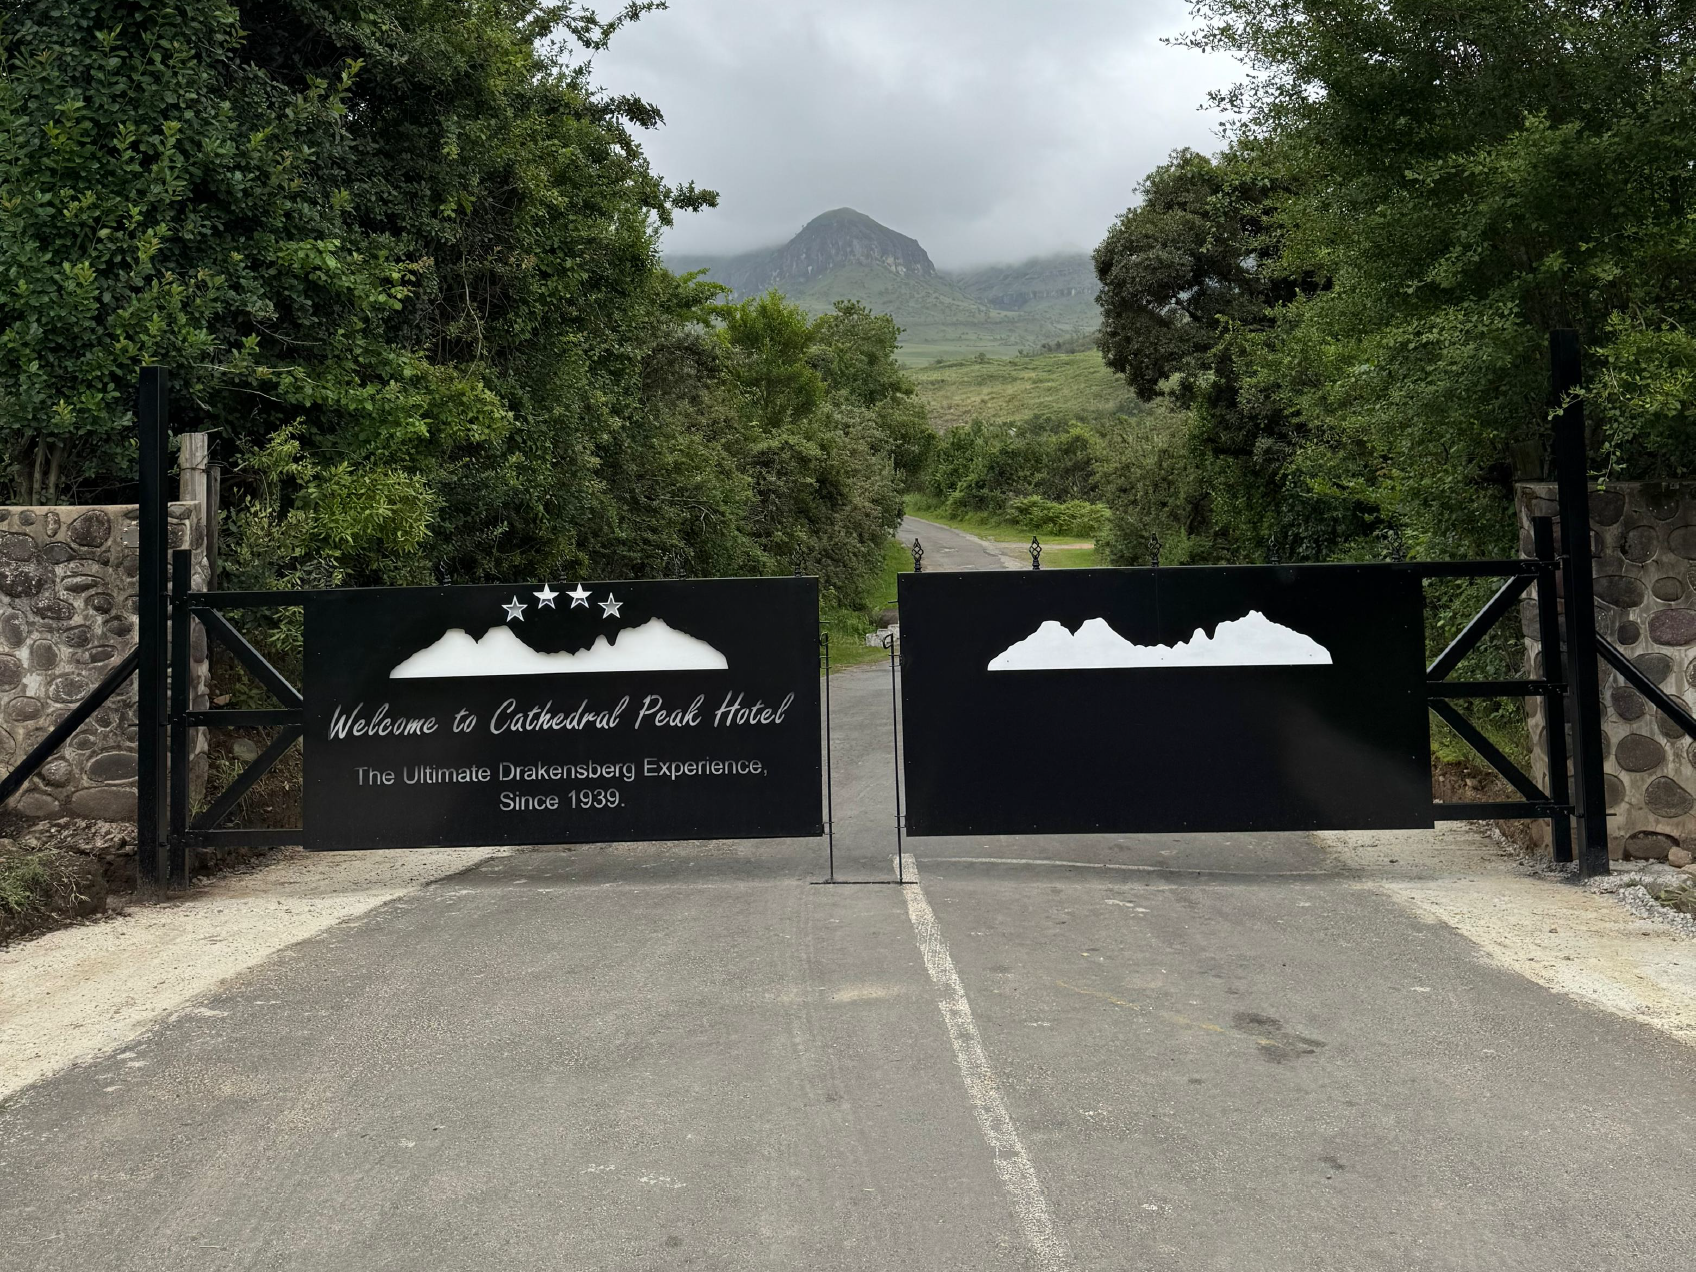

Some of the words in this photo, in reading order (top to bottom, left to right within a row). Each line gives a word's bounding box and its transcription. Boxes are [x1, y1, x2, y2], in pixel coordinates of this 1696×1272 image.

[328, 702, 439, 740] Welcome
[452, 708, 477, 733] to
[489, 694, 630, 735] Cathedral
[635, 694, 705, 730] Peak
[714, 691, 795, 728] Hotel
[356, 766, 395, 786] The
[403, 765, 491, 785] Ultimate
[499, 760, 636, 782] Drakensberg
[644, 757, 769, 781] Experience,
[499, 791, 559, 811] Since
[568, 788, 626, 809] 1939.
